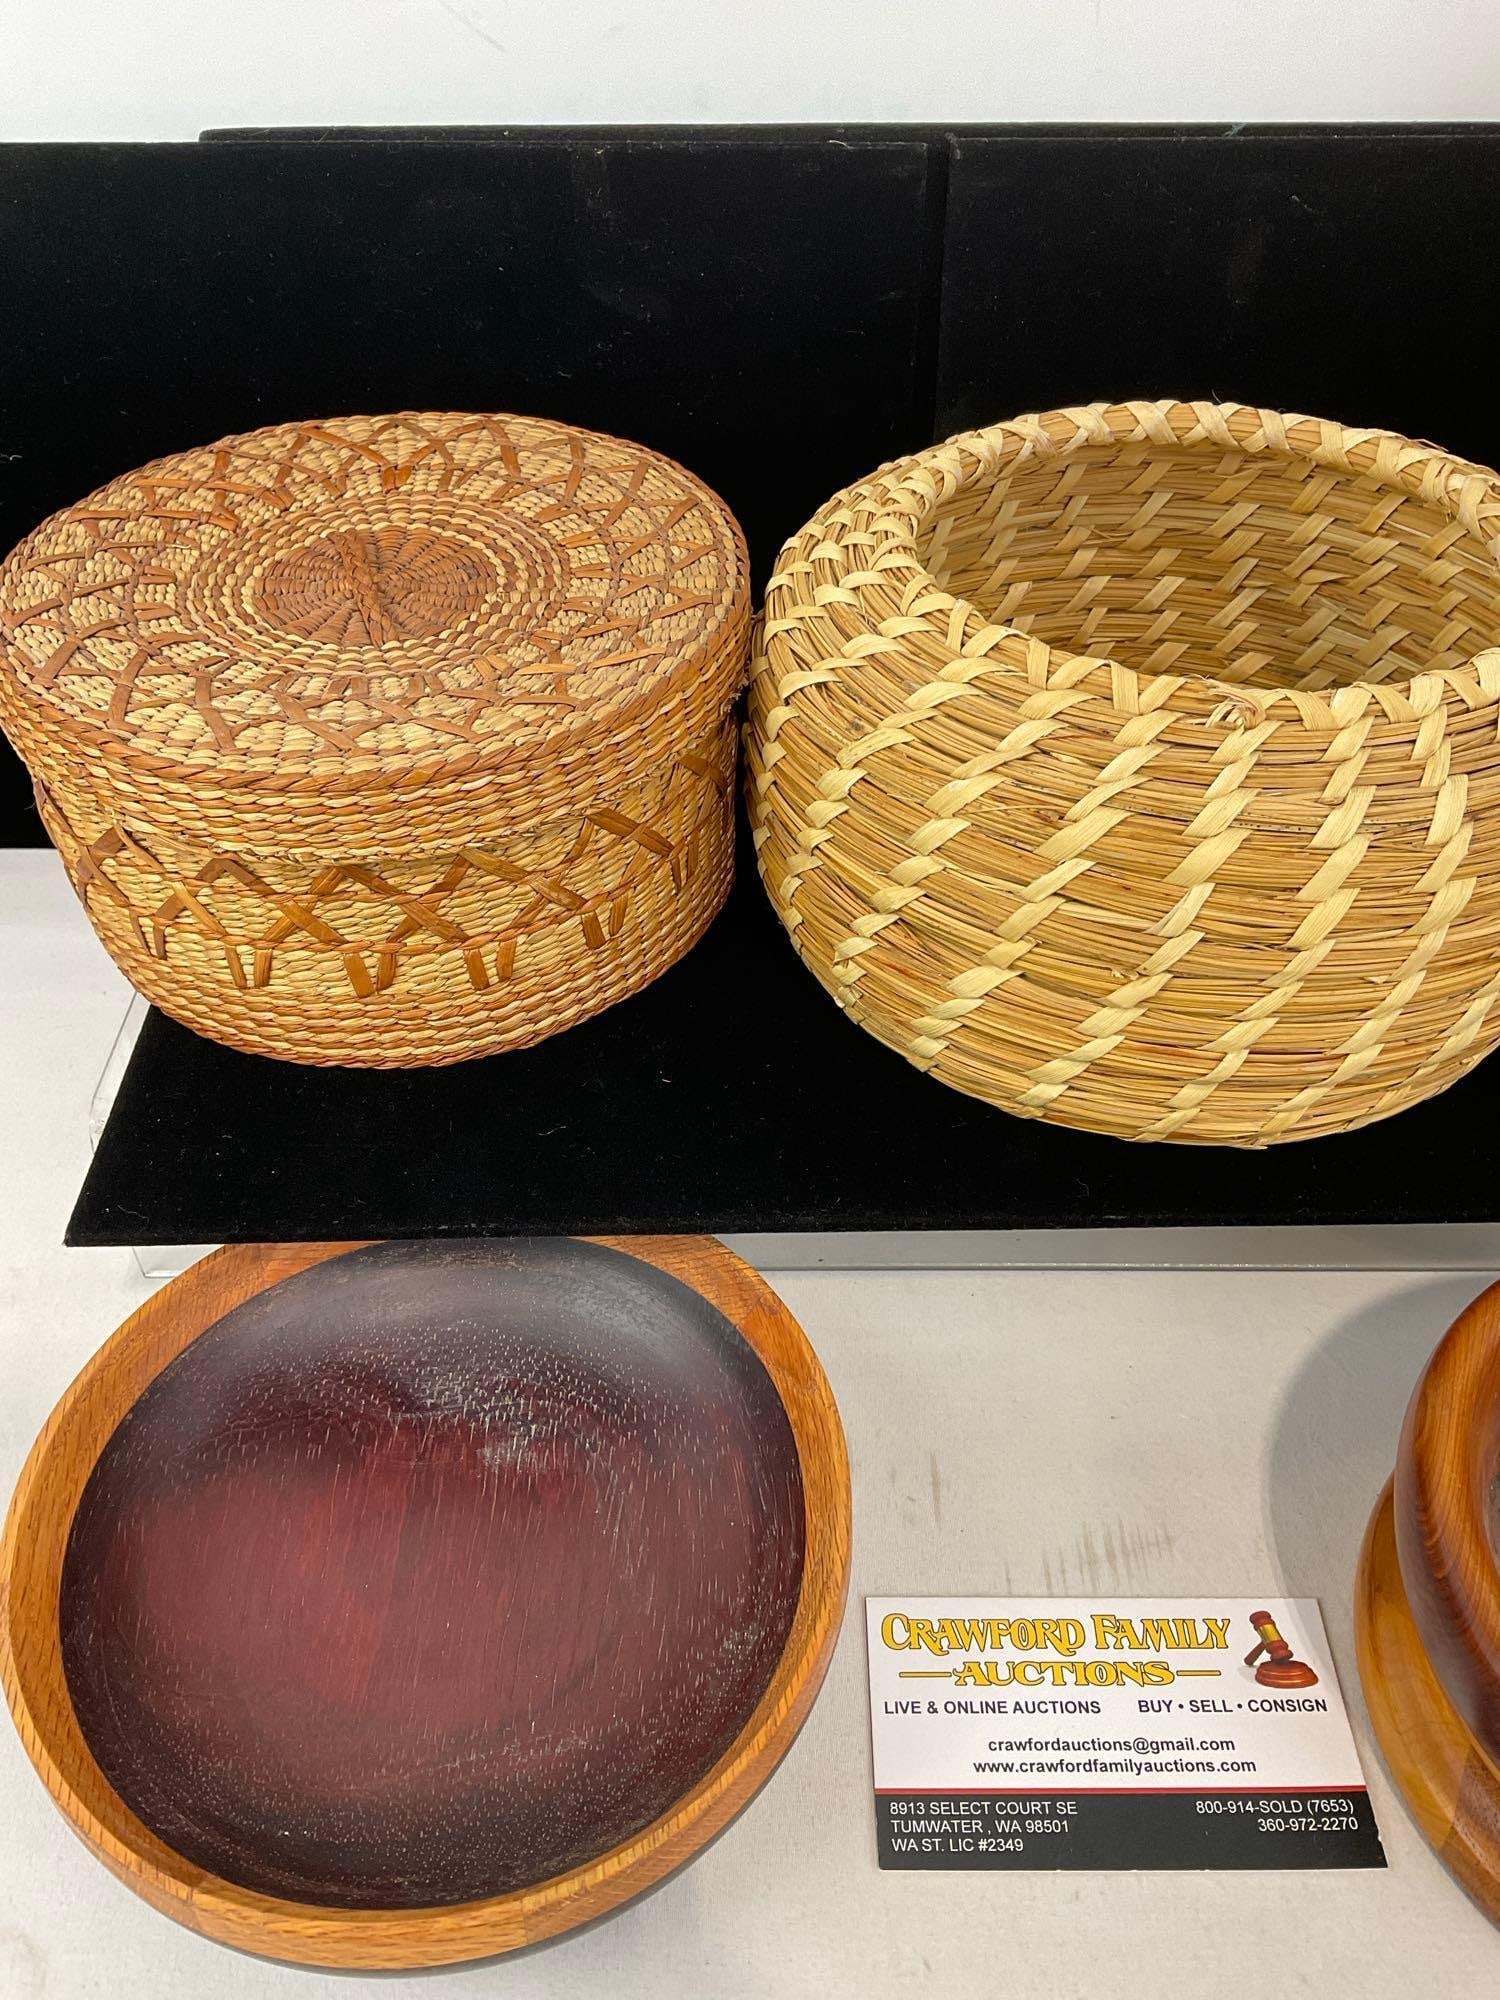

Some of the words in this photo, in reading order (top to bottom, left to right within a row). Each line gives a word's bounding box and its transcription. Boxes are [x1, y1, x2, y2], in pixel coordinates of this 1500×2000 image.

[881, 1612, 1086, 1656] CRAWFORD
[1090, 1614, 1231, 1652] FAMILY
[952, 1661, 1175, 1687] AUCTIONS
[884, 1701, 922, 1714] LIVE
[926, 1701, 938, 1714] &
[943, 1700, 1008, 1714] ONLINE
[1012, 1700, 1101, 1714] AUCTIONS
[1138, 1700, 1173, 1713] BUY
[1189, 1699, 1233, 1713] SELL
[1249, 1699, 1328, 1712] CONSIGN
[988, 1738, 1236, 1754] crawfordauctions@gmail.com
[973, 1759, 1257, 1776] www.crawfordfamilyauctions.com
[889, 1802, 925, 1815] 8913
[929, 1801, 990, 1815] SELECT
[995, 1801, 1051, 1815] COURT
[1056, 1801, 1078, 1815] SE
[1196, 1800, 1303, 1814] 800-914-SOLD
[1307, 1799, 1354, 1815] (7653)
[994, 1820, 1022, 1833] WA
[1025, 1819, 1069, 1833] 98501
[1258, 1817, 1358, 1831] 360-972-2270
[892, 1839, 918, 1852] WA
[921, 1839, 944, 1852] ST.
[950, 1839, 974, 1852] LIC
[978, 1838, 1024, 1852] #2349
